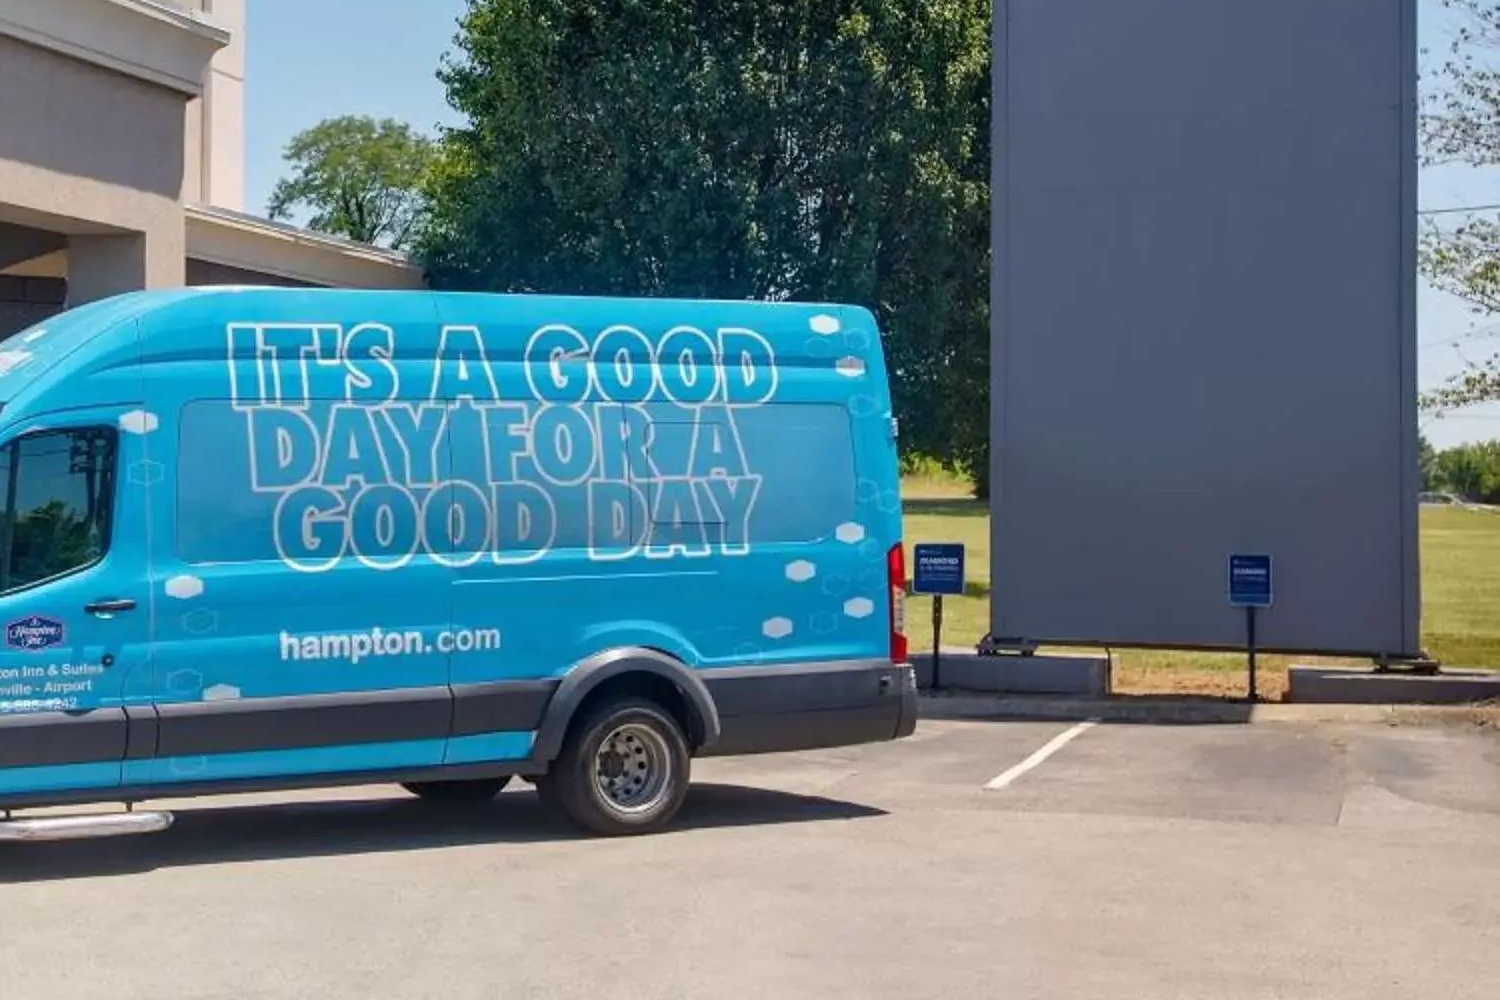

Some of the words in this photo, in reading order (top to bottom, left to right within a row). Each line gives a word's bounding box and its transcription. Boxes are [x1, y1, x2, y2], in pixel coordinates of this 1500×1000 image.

[227, 322, 399, 411] IT'S
[430, 325, 501, 410] A
[524, 324, 779, 408] GOOD
[247, 403, 451, 492] DAY
[479, 402, 662, 487] FOR
[687, 402, 751, 480] A
[275, 480, 557, 572] GOOD
[587, 474, 763, 561] DAY
[22, 664, 45, 677] Inn
[47, 663, 59, 676] &
[63, 662, 104, 675] Suites
[43, 679, 93, 695] Airport
